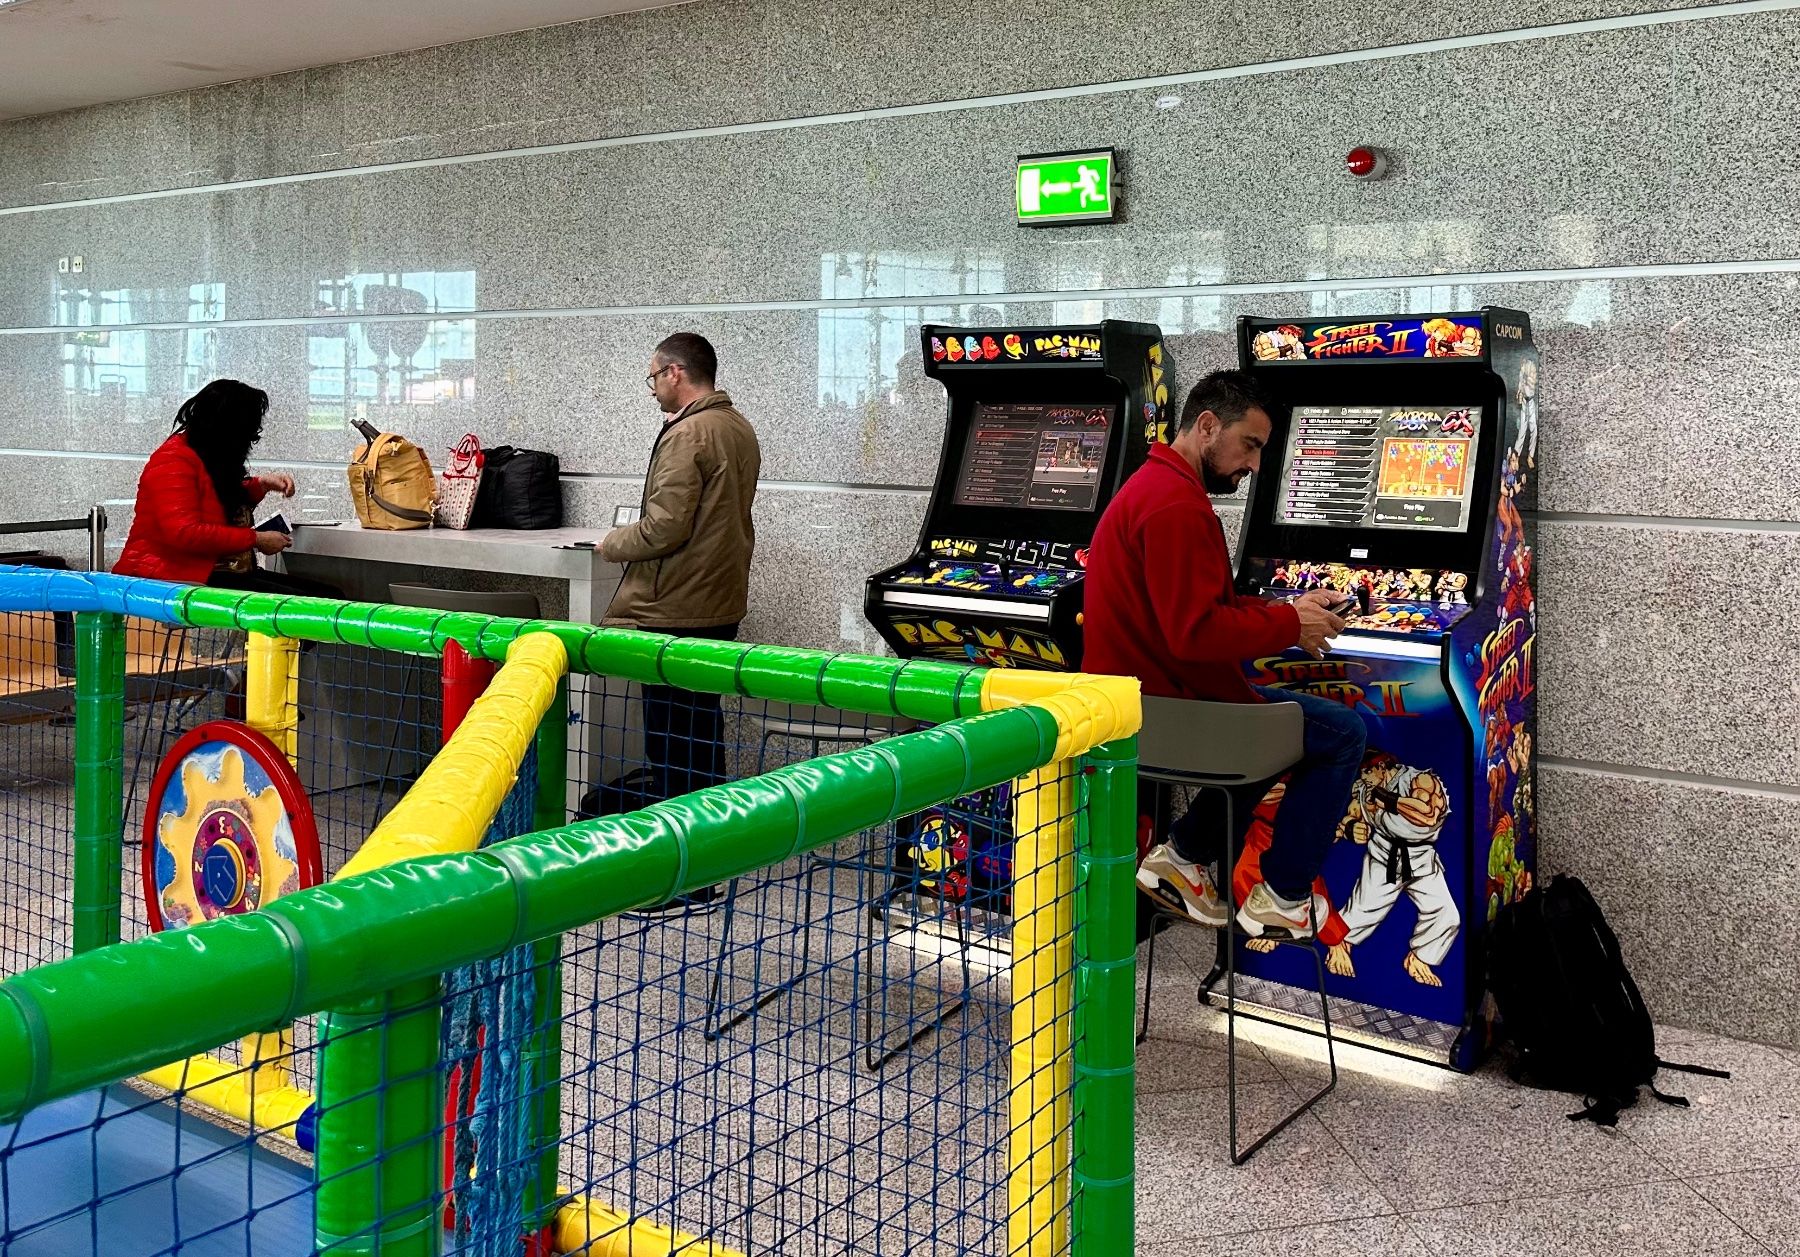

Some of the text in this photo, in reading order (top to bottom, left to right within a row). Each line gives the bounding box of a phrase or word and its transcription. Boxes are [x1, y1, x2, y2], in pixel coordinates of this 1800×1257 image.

[1034, 334, 1101, 352] PAC-MAN
[1305, 322, 1393, 347] STREET
[1309, 328, 1419, 359] FIGHTER II
[1495, 323, 1523, 340] CAPCOM
[931, 538, 978, 554] PAC-MAN
[891, 619, 1067, 666] PAC-MAN
[1475, 618, 1525, 691] STREET
[1247, 656, 1373, 686] STREET
[1478, 633, 1537, 728] FIGHTER II
[1369, 681, 1425, 718] II
